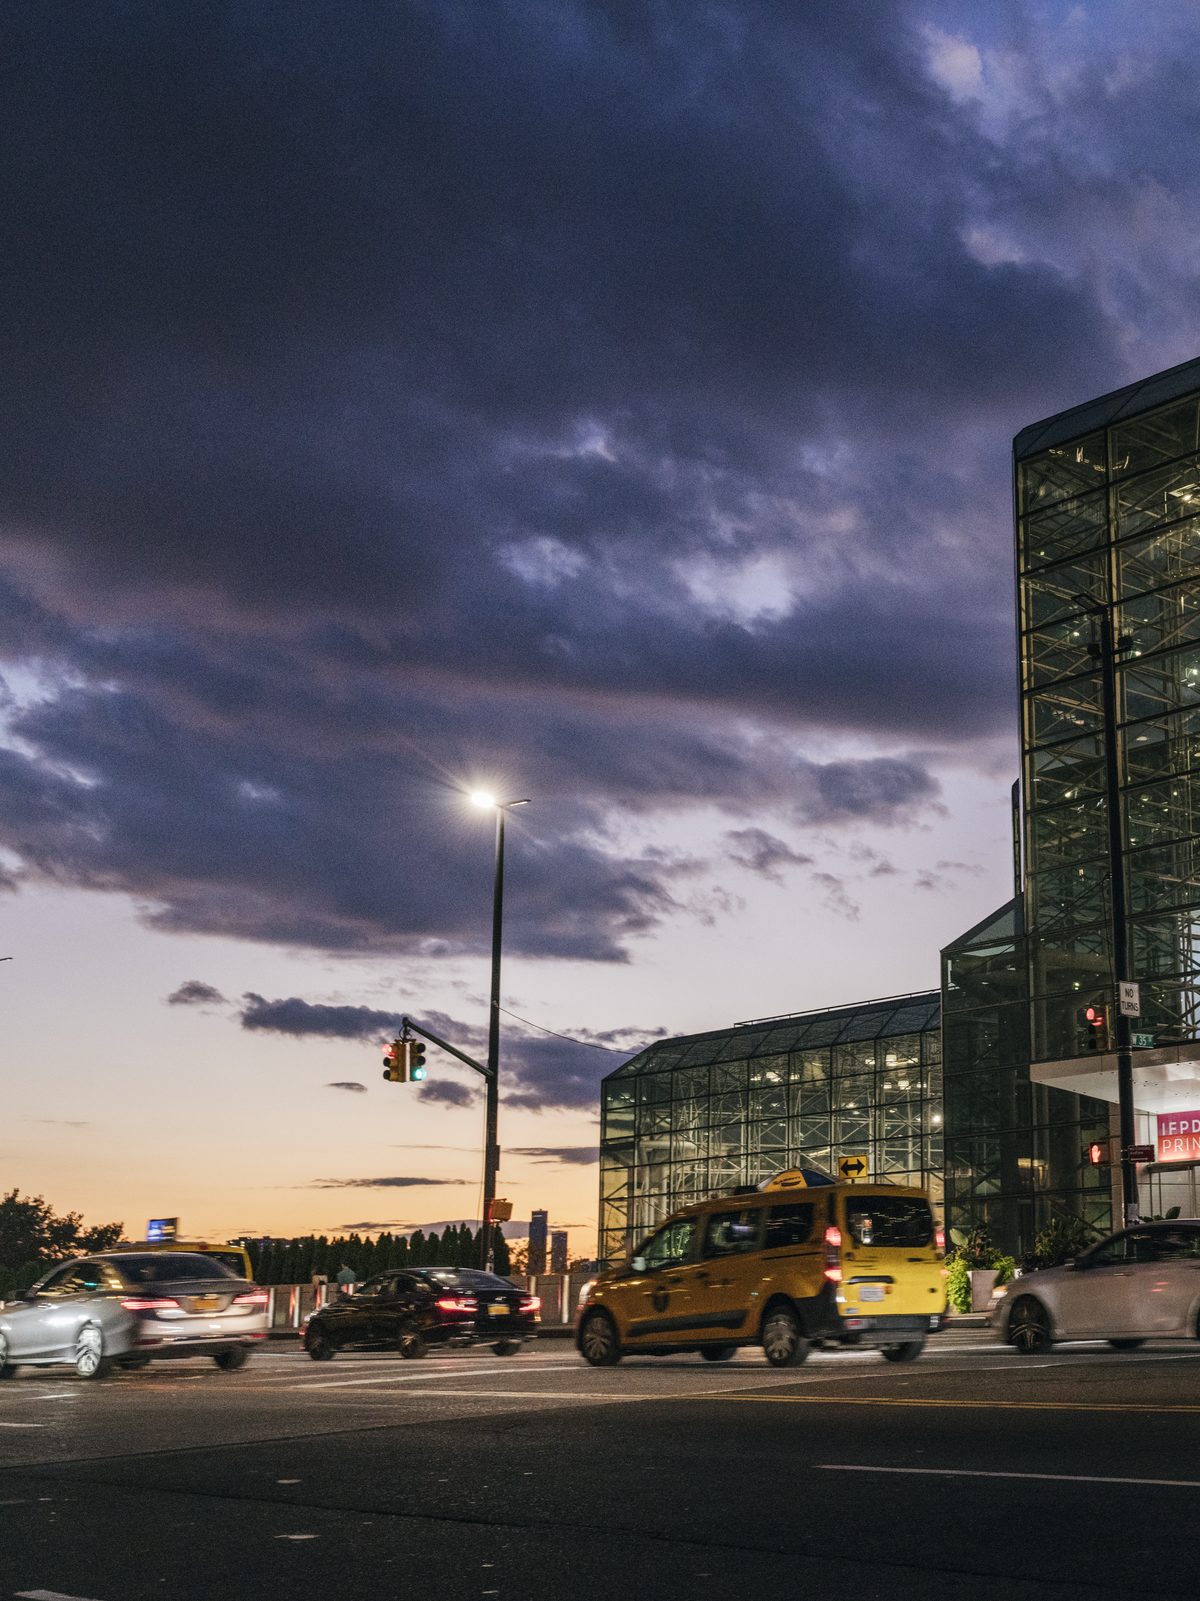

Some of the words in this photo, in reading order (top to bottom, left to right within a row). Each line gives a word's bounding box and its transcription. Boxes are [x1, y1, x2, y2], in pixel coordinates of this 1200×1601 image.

[1125, 988, 1134, 998] NO
[1121, 1001, 1139, 1012] TURNS
[1138, 1035, 1147, 1046] 35
